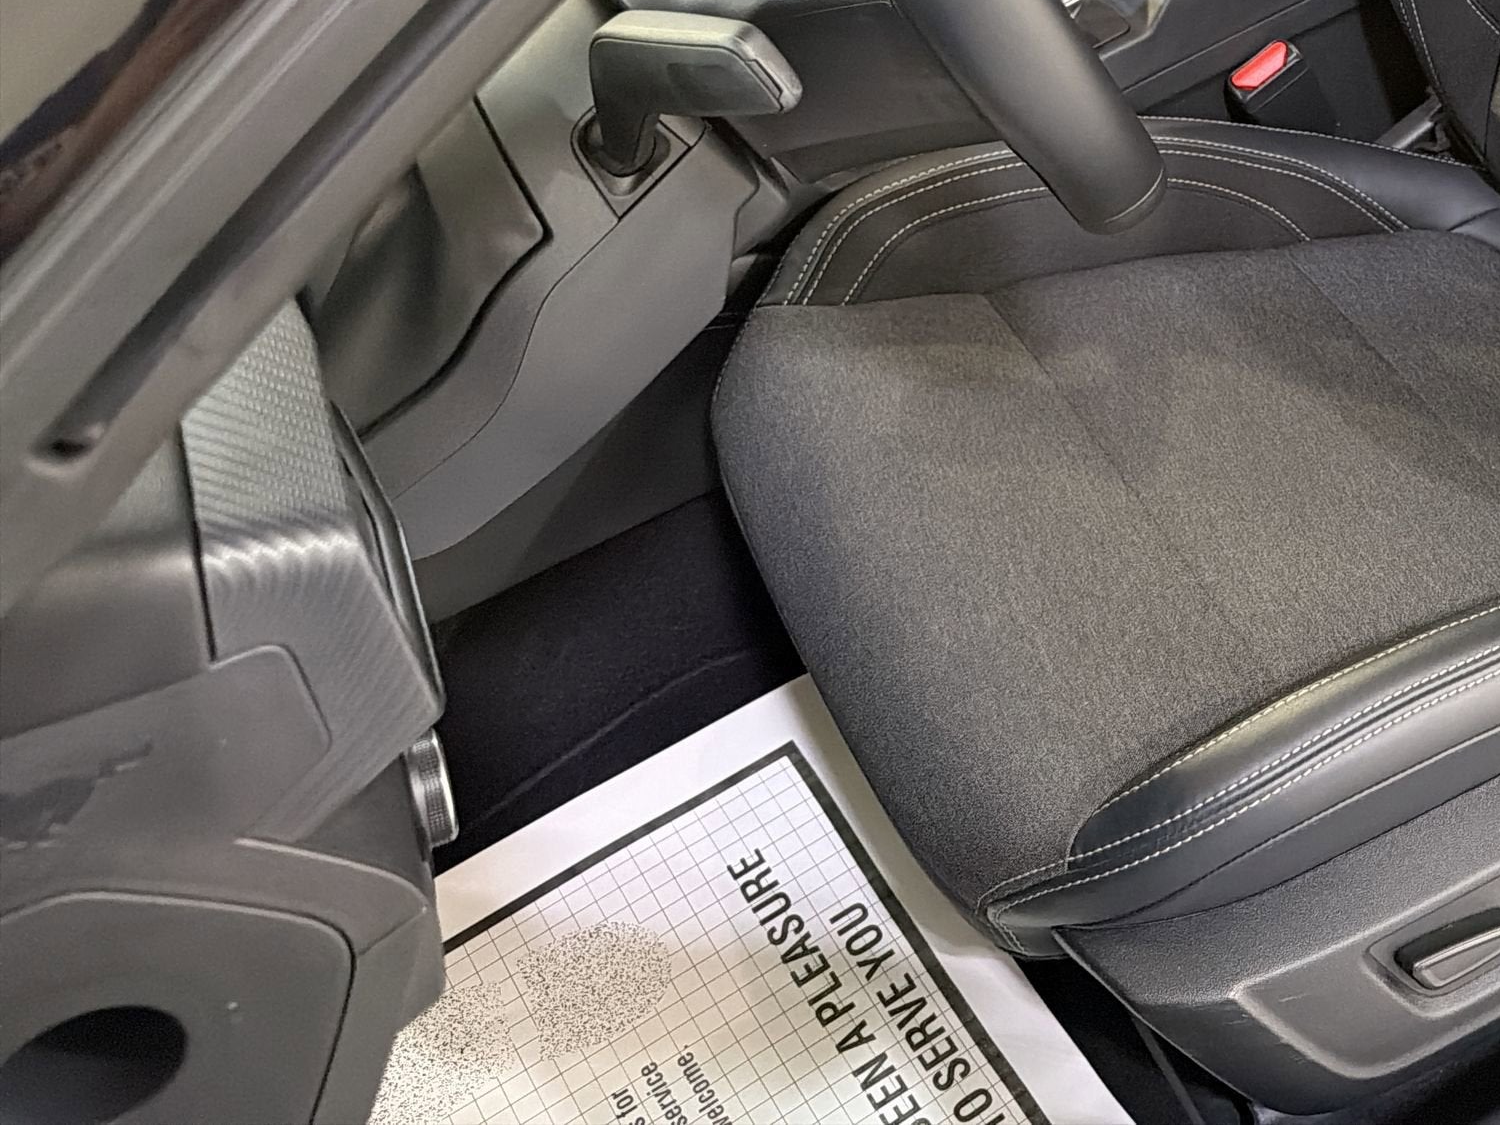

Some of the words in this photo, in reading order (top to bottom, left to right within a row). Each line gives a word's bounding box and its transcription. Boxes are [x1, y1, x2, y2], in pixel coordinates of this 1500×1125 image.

[726, 848, 856, 1027] PLEASURE
[829, 902, 896, 980] YOU
[836, 1020, 876, 1053] A
[877, 972, 971, 1091] SERVE
[611, 1088, 638, 1119] for
[641, 1061, 688, 1125] service
[853, 1052, 932, 1125] EEN
